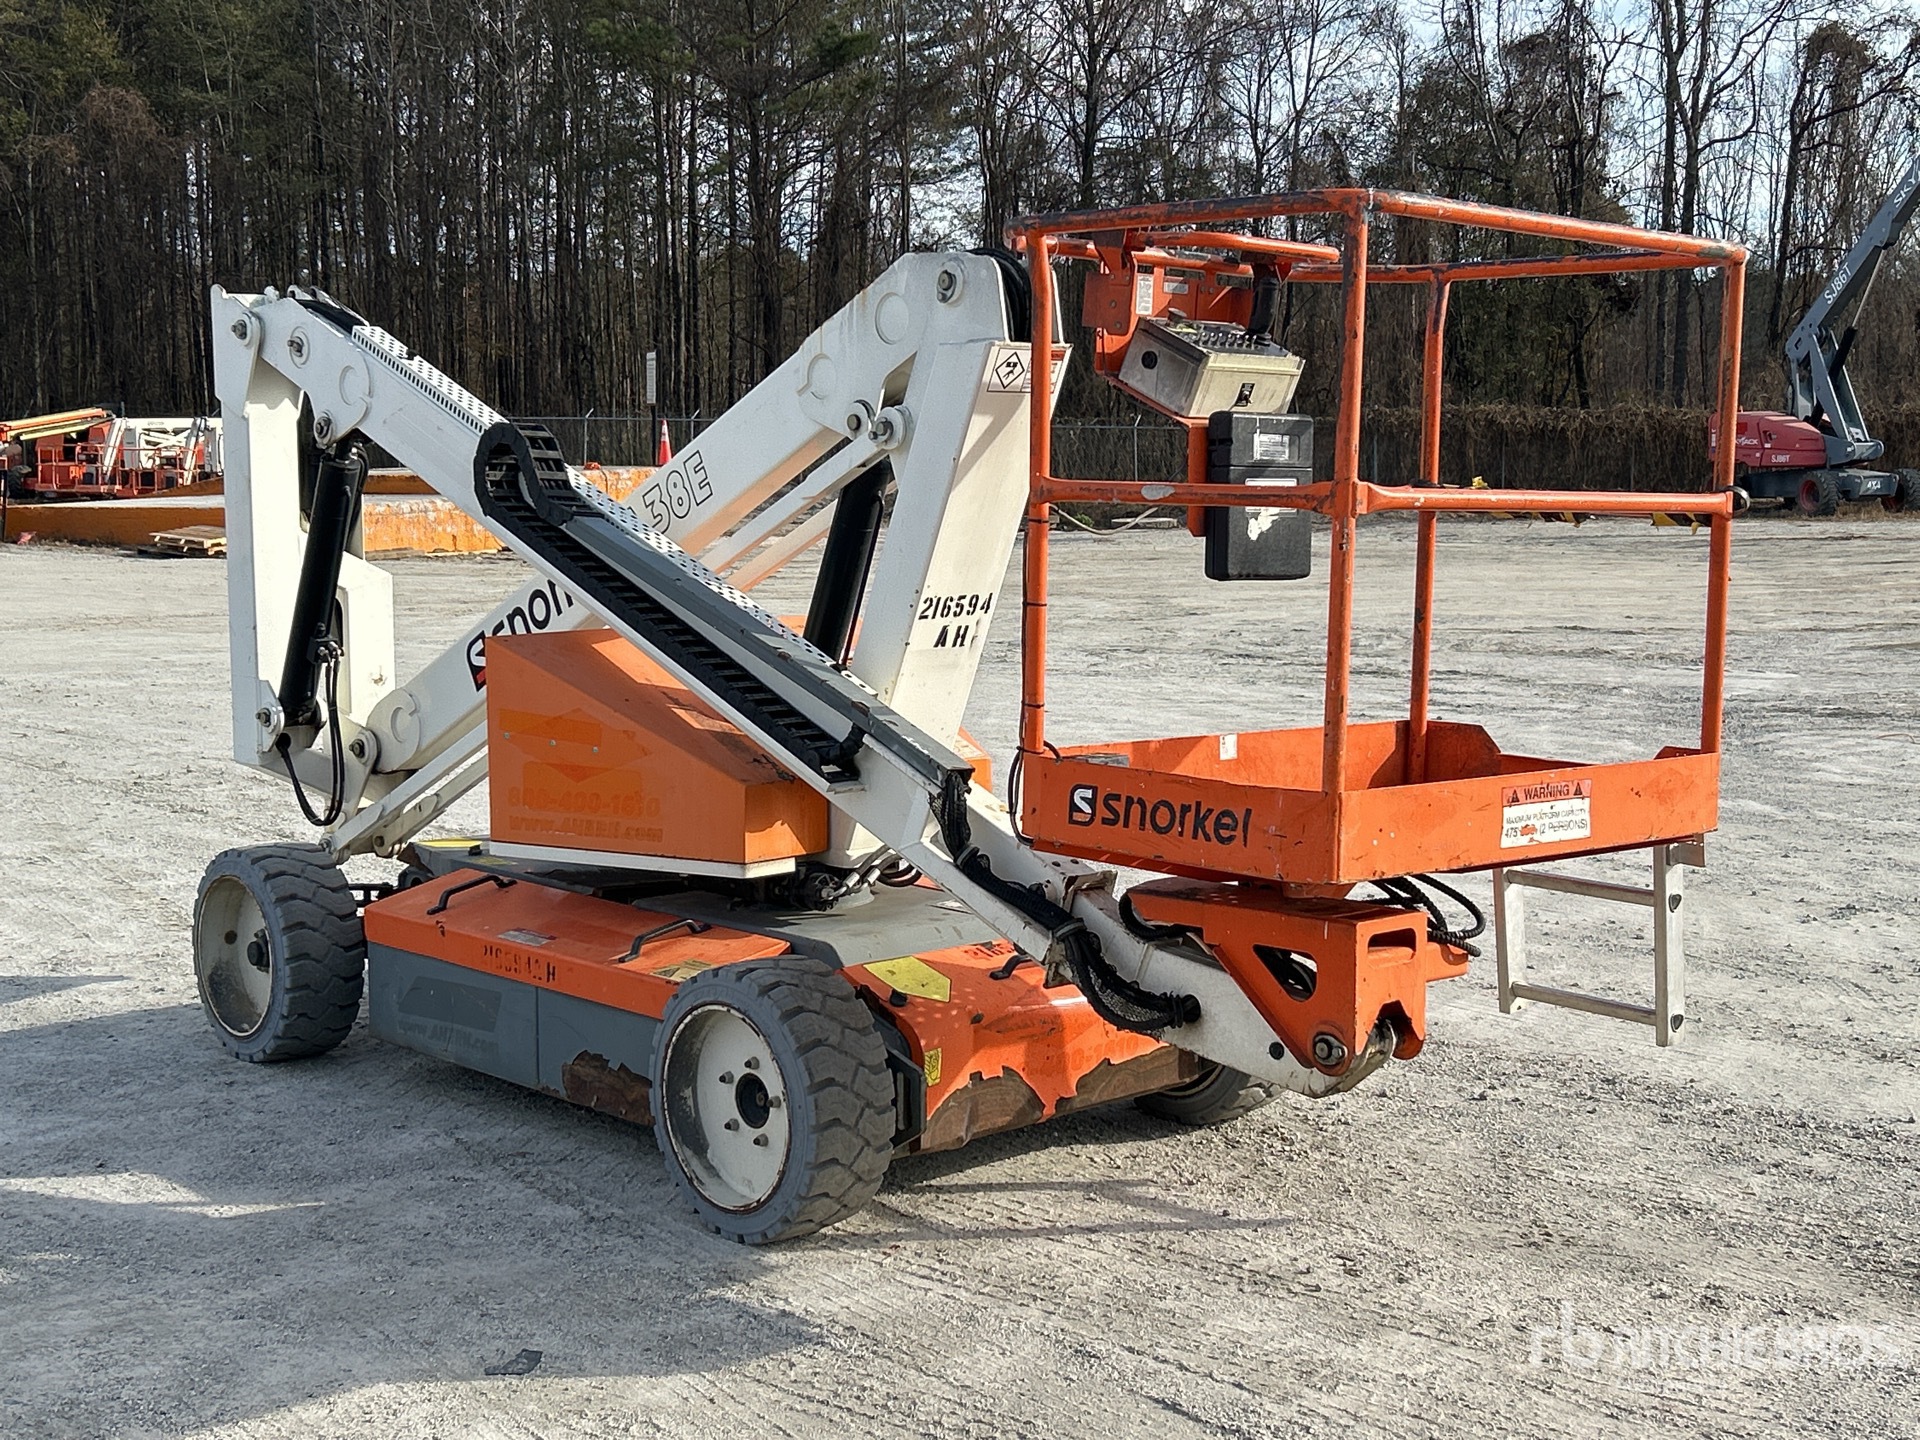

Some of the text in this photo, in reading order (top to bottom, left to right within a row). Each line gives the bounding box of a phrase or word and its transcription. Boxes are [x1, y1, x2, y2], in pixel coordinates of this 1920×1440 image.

[1824, 262, 1851, 304] SJ86T
[627, 450, 713, 534] 38E
[918, 592, 993, 620] 216594
[933, 625, 969, 648] AH
[1523, 784, 1570, 800] WARNING
[1101, 793, 1253, 848] snorkel
